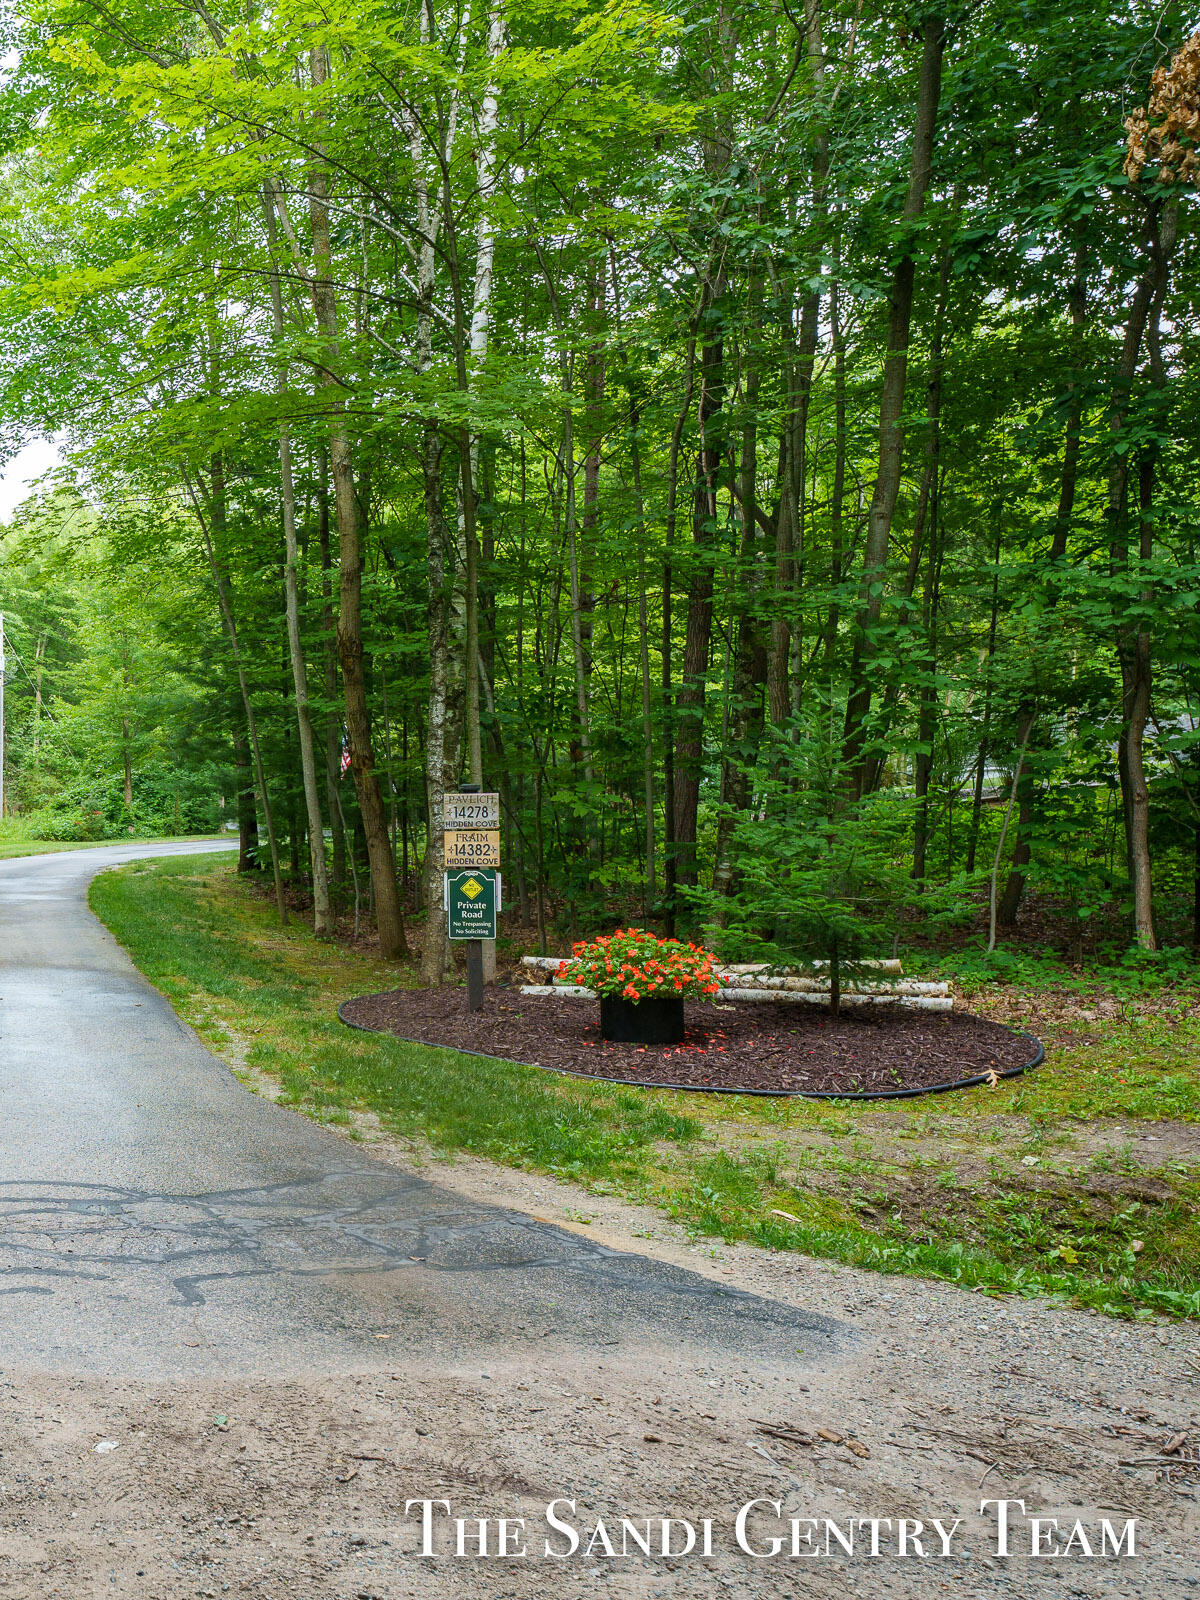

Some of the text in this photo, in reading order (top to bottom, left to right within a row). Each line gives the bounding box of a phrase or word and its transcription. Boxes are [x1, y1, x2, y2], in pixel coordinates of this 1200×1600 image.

[448, 795, 493, 804] PAVLICH
[453, 806, 489, 818] 14278
[456, 833, 488, 842] FRAIM
[454, 843, 491, 856] 14382
[457, 901, 487, 909] Private
